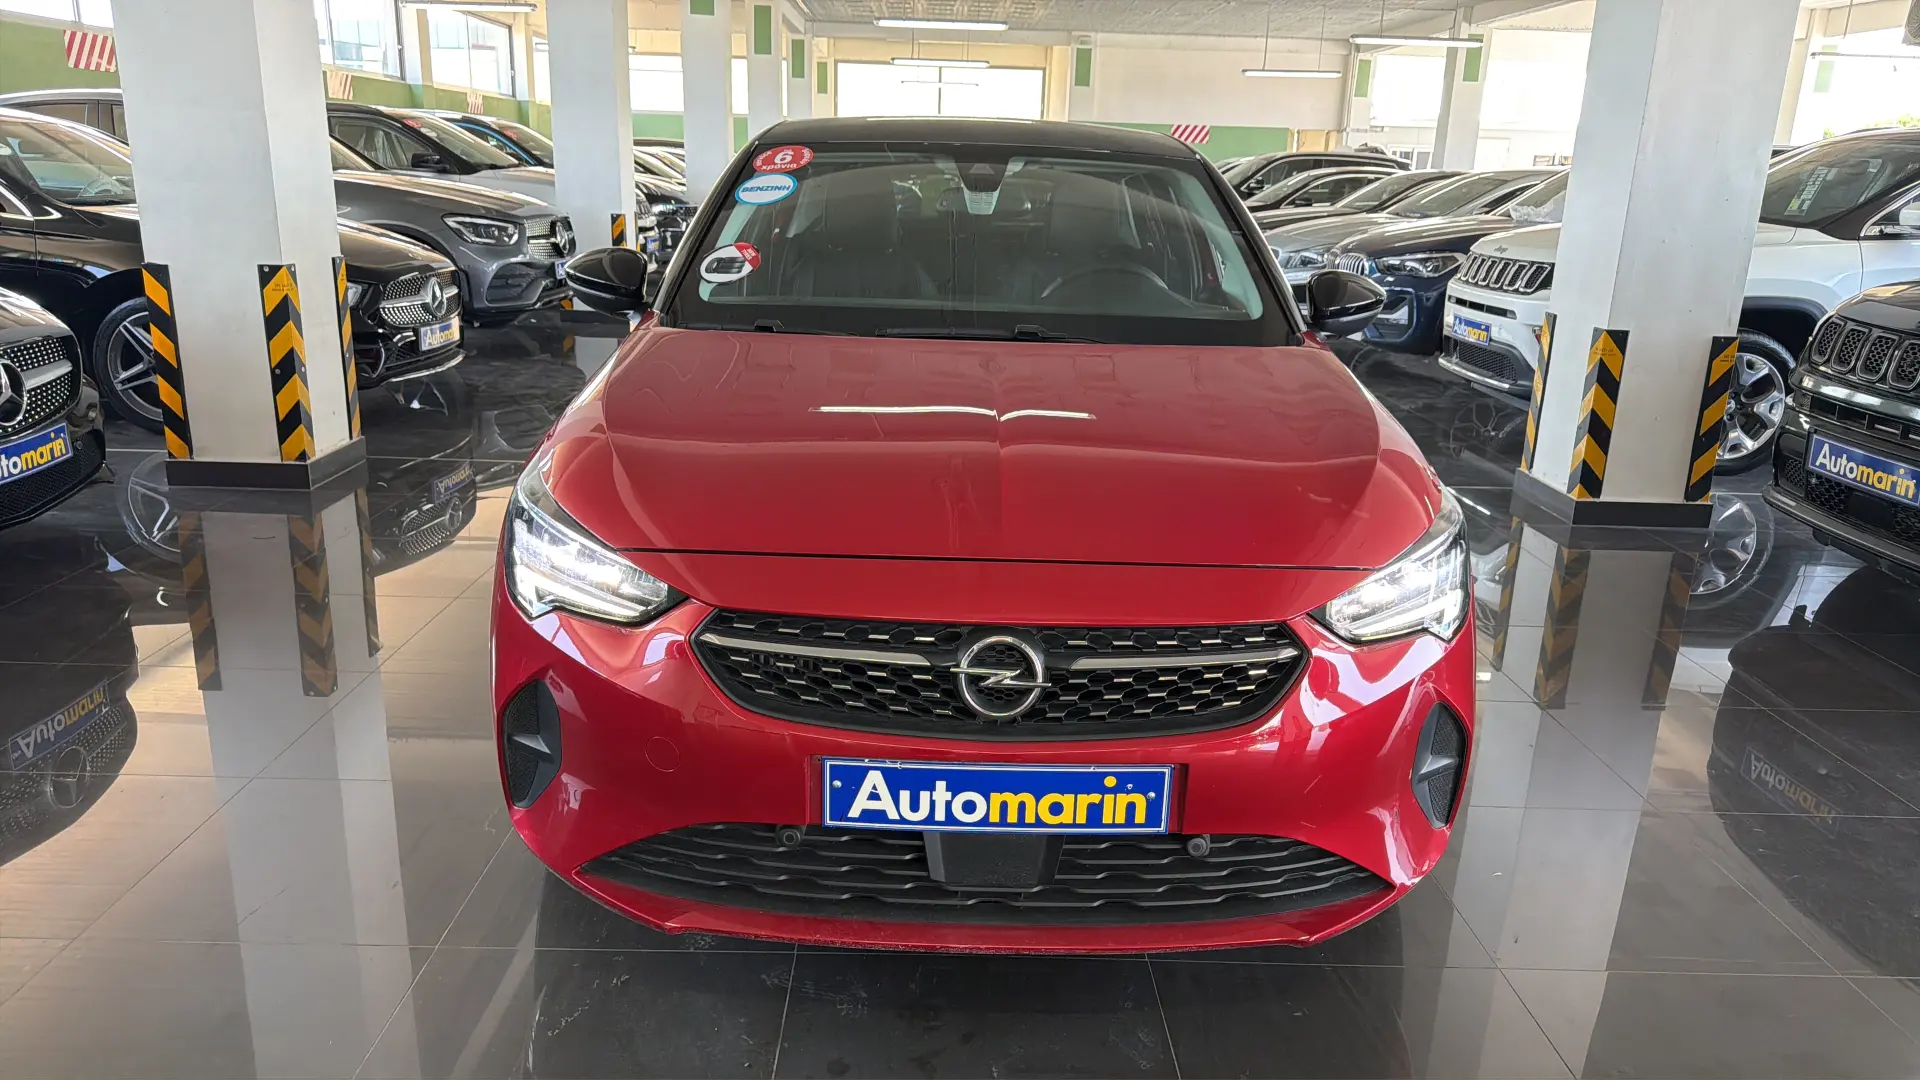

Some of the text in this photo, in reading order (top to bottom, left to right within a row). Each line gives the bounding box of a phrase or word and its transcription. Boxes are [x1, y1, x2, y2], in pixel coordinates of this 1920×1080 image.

[774, 151, 794, 164] 6
[0, 431, 66, 478] tomarin
[1815, 443, 1915, 499] Automarin
[847, 770, 1147, 825] Automarin
